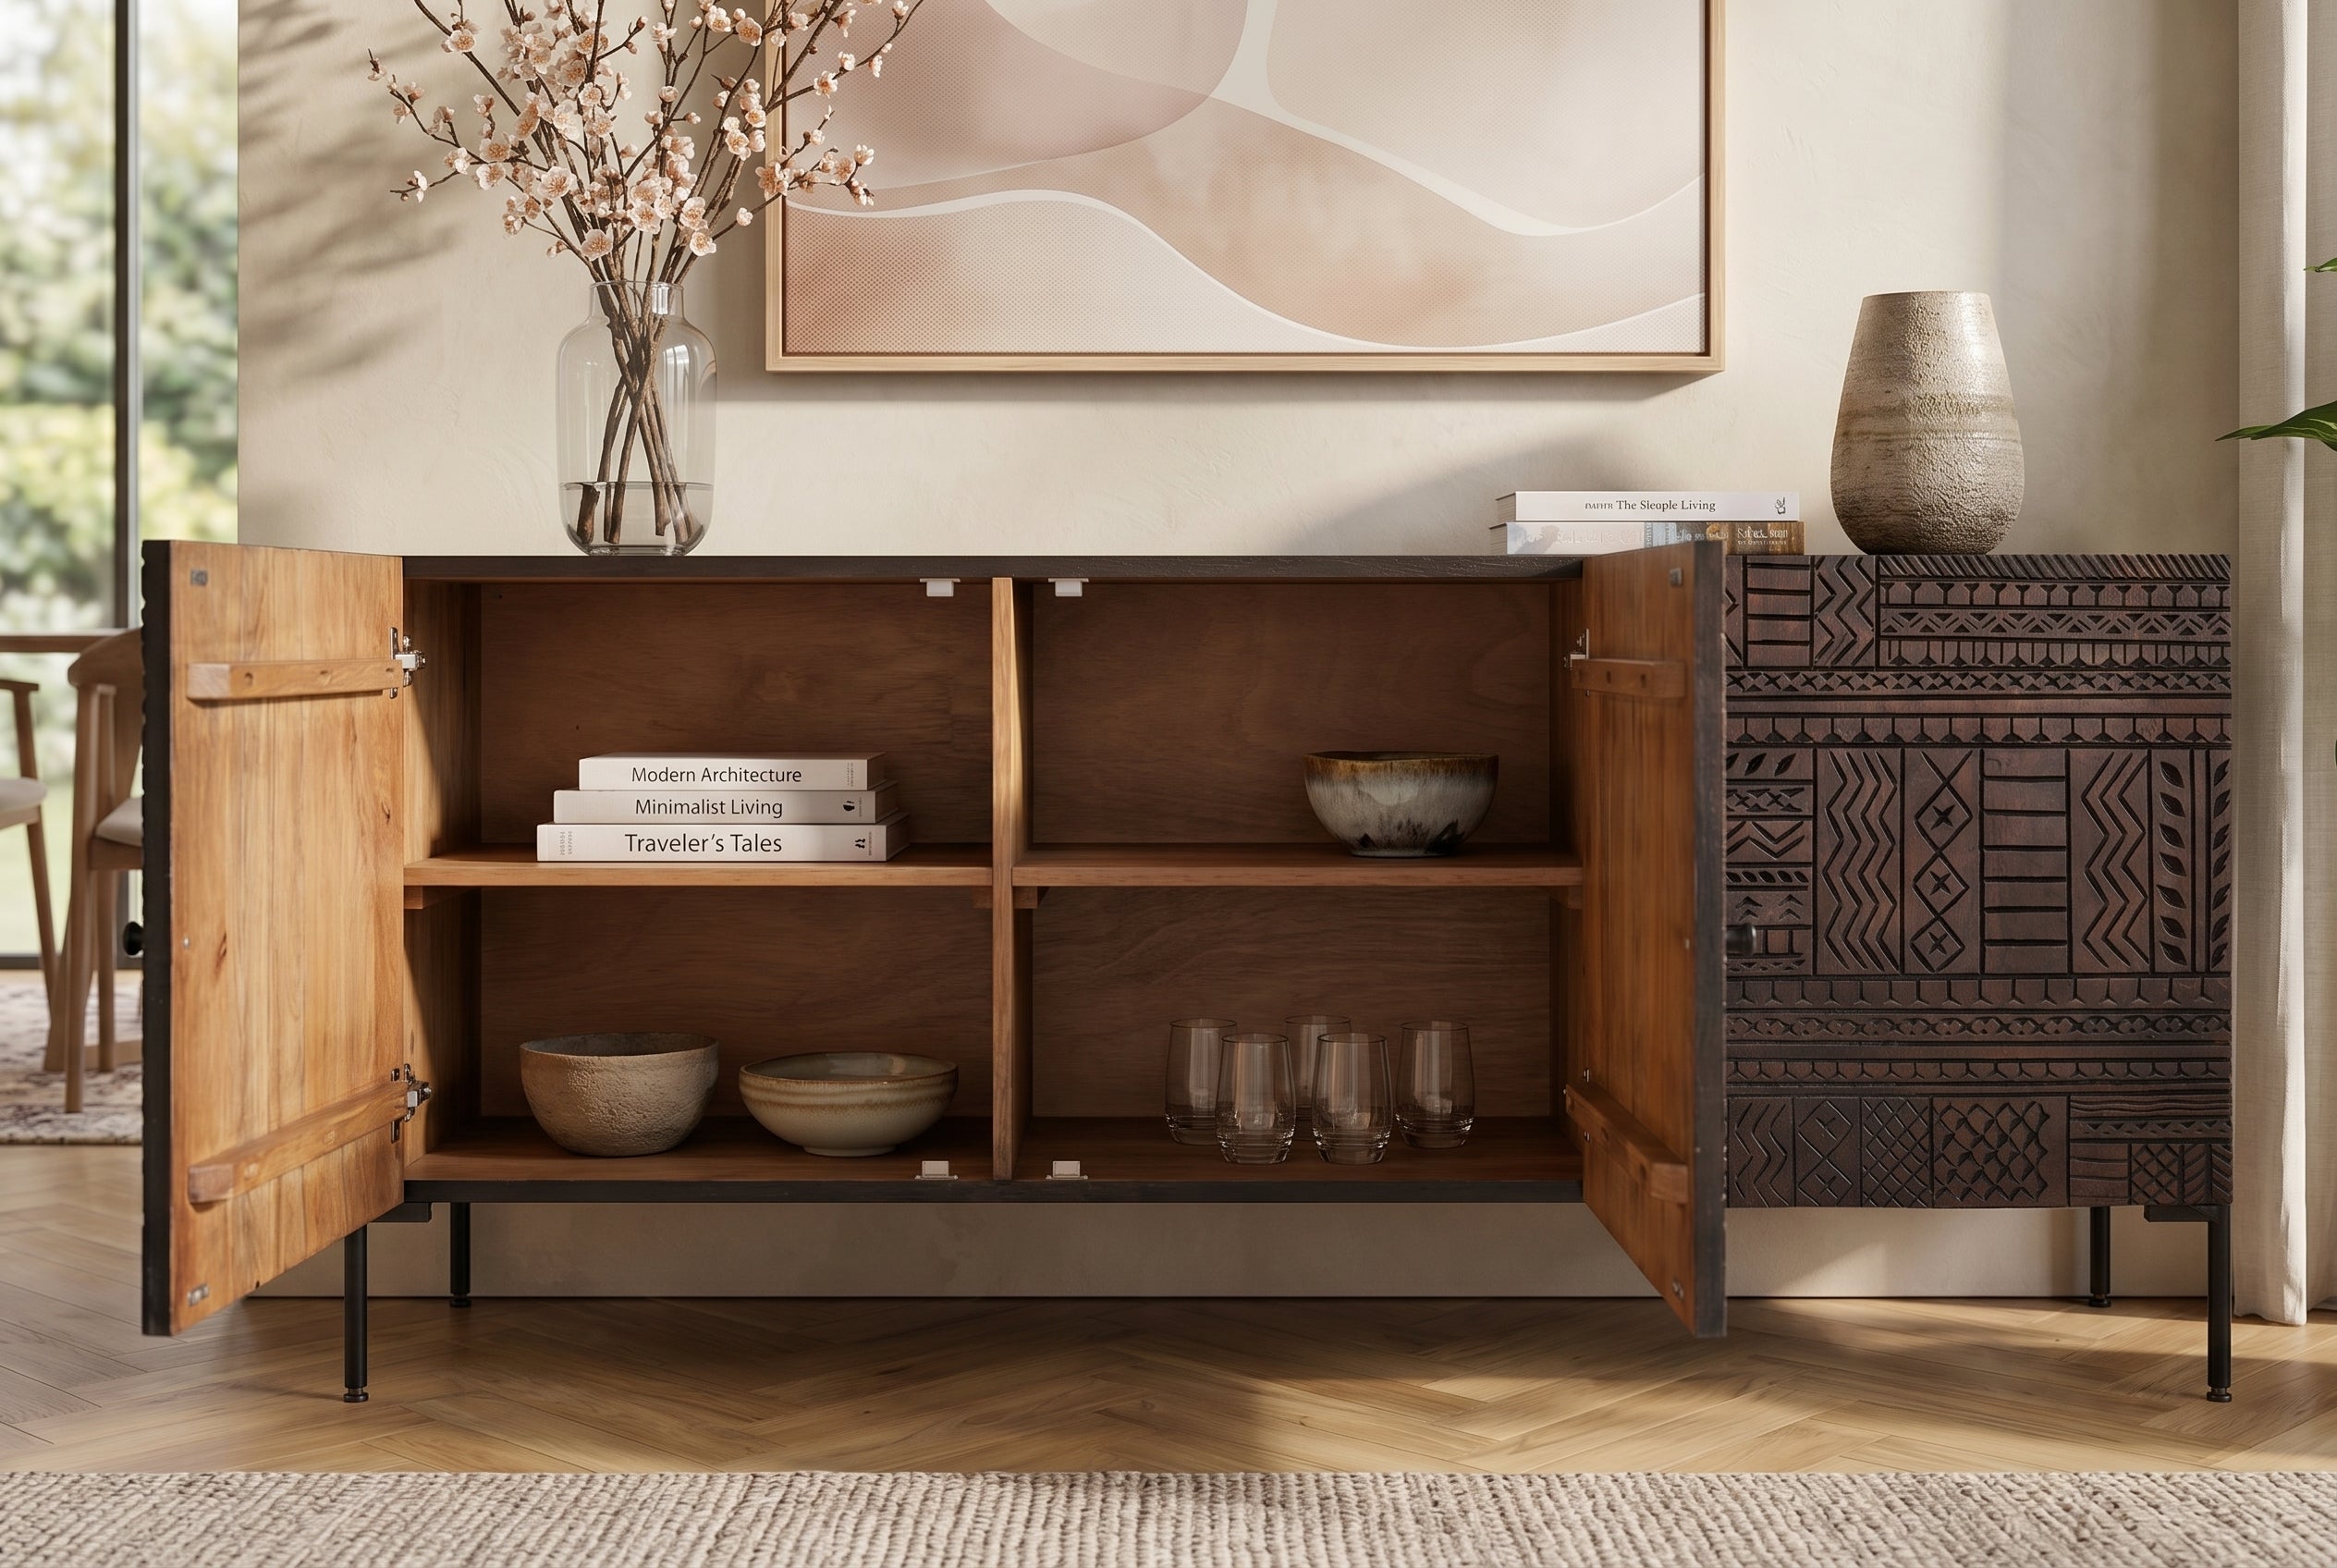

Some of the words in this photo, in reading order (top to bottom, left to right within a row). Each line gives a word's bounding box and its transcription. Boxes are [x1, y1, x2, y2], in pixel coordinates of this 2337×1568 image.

[1616, 499, 1637, 510] The
[1681, 500, 1717, 512] Living
[631, 766, 696, 783] Modern
[701, 766, 802, 783] Architecture
[635, 798, 727, 815] Minimalist
[731, 798, 784, 820] Living
[624, 833, 725, 852] Traveler’s
[730, 833, 783, 852] Tales
